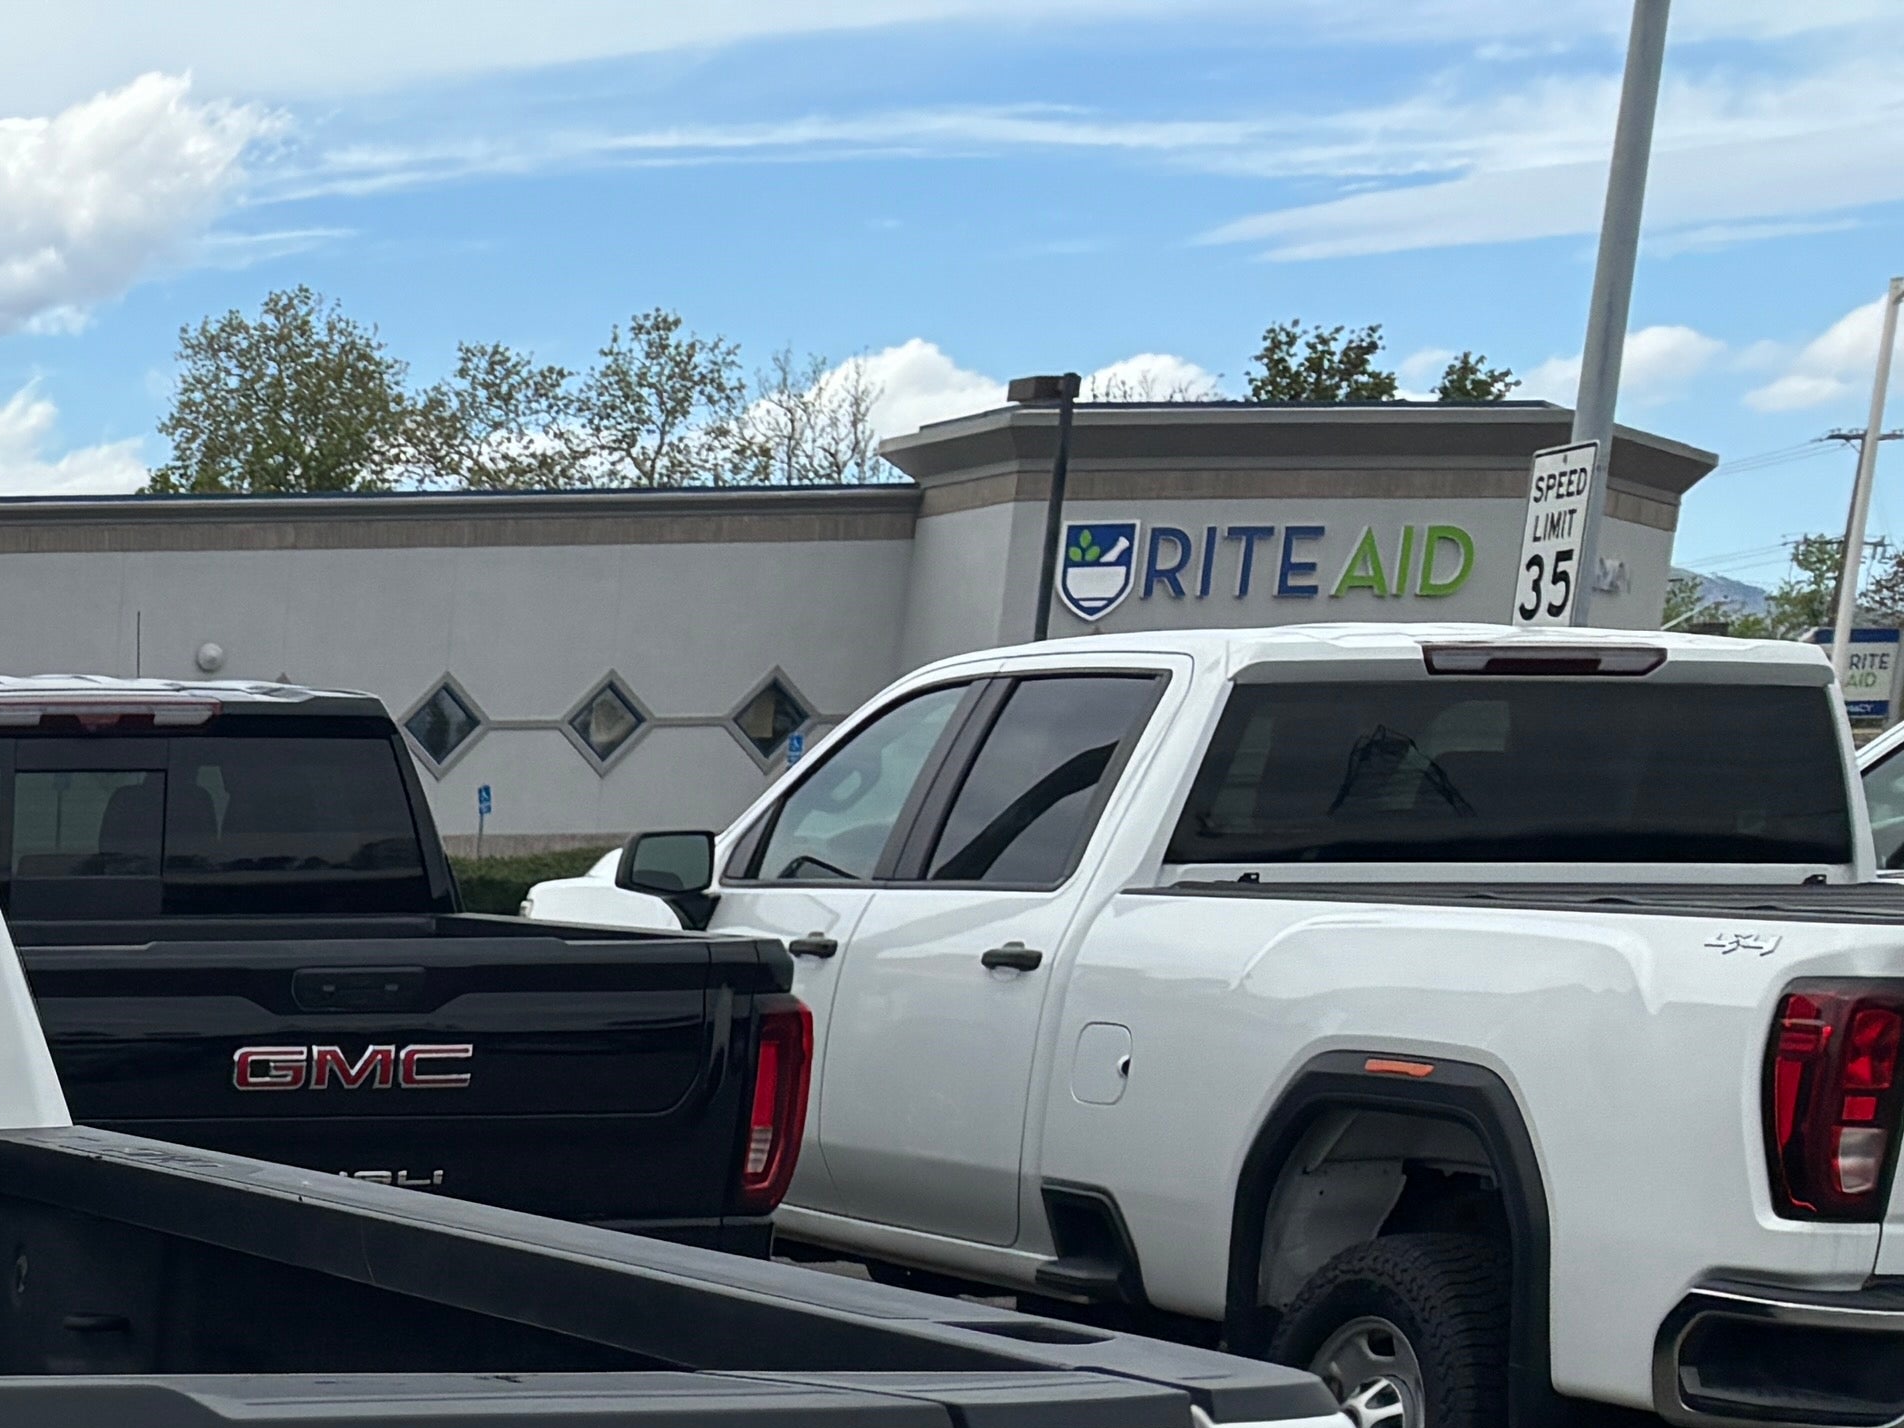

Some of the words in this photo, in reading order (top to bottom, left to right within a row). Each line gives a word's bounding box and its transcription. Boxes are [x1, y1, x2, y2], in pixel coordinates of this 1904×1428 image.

[1533, 467, 1588, 503] SPEED
[1532, 508, 1578, 542] LIMIT
[1140, 524, 1325, 600] RITE
[1328, 524, 1476, 599] AID
[1519, 549, 1574, 621] 35
[1849, 652, 1891, 670] RITE
[1847, 671, 1877, 688] AID
[233, 1044, 473, 1090] GMC
